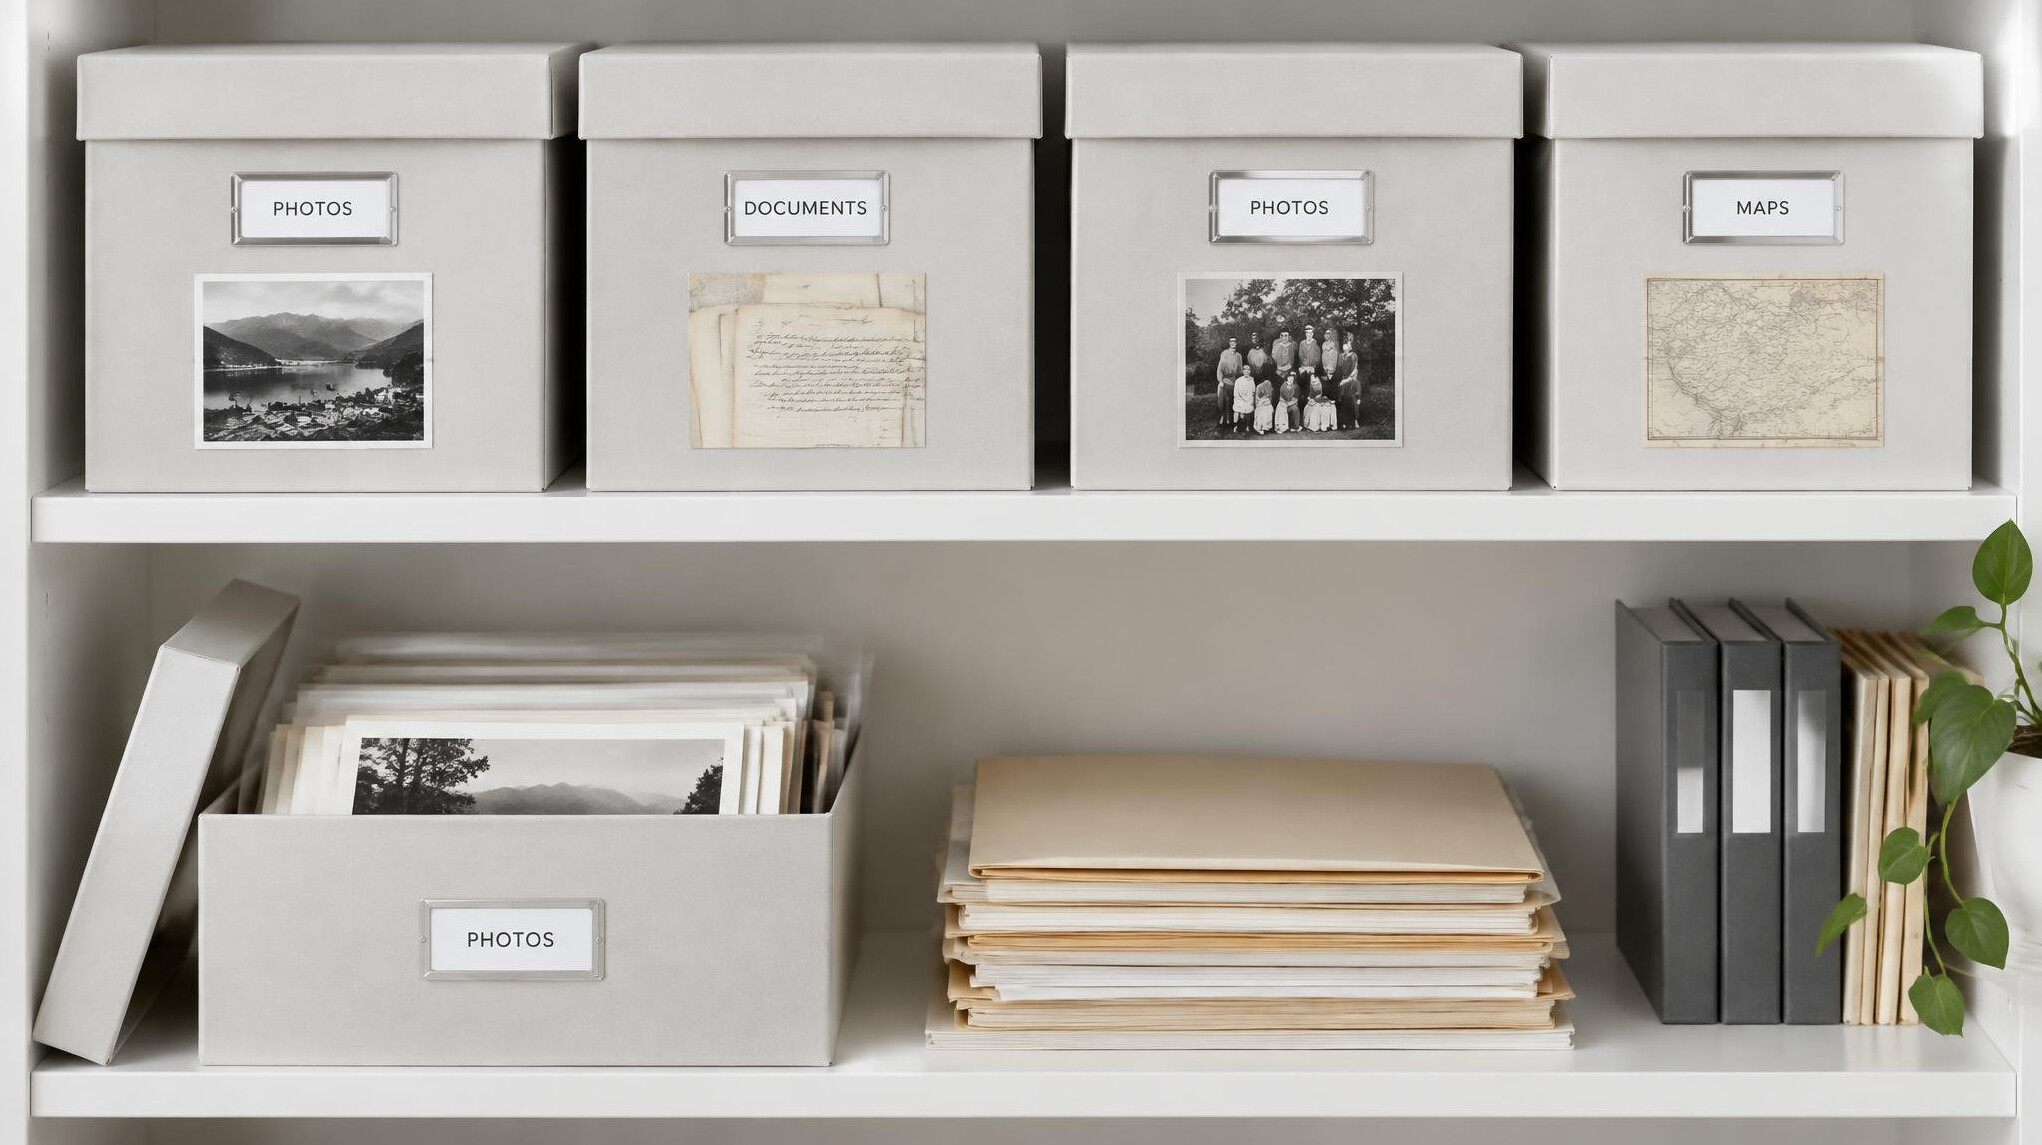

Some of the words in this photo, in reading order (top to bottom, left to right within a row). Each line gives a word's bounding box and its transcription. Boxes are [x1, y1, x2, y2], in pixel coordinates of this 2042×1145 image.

[273, 201, 353, 216] PHOTOS
[743, 200, 868, 216] DOCUMENTS
[1250, 200, 1330, 216] PHOTOS
[1736, 200, 1790, 216] MAPS
[467, 931, 555, 948] PHOTOS
